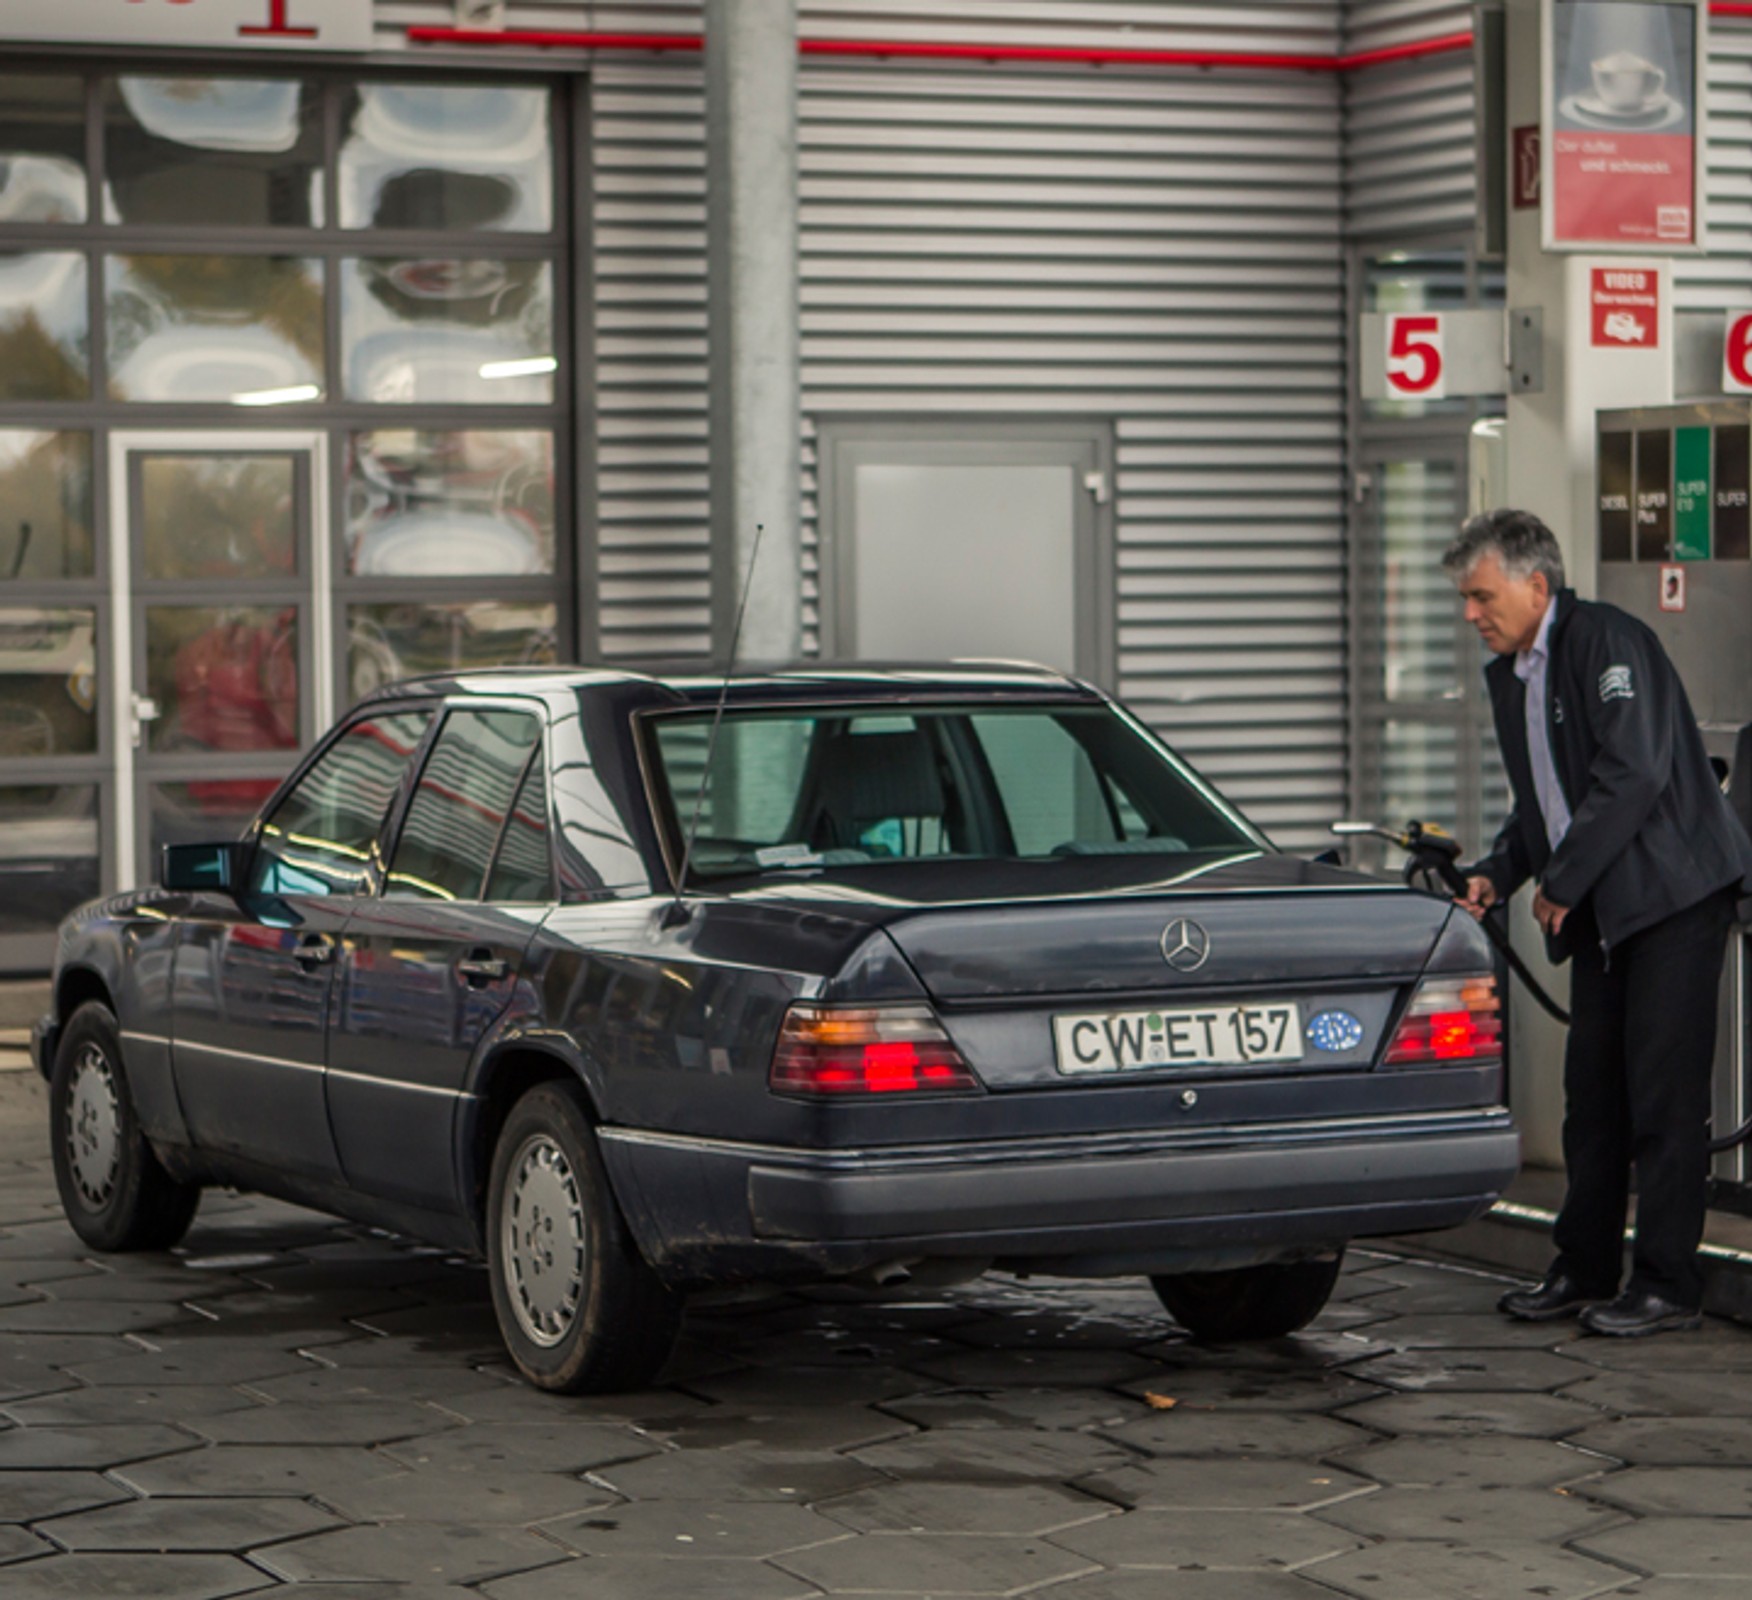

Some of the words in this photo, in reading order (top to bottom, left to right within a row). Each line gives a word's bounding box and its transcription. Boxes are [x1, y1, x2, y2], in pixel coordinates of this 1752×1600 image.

[1603, 272, 1647, 290] VIDEO
[1386, 316, 1442, 393] 5
[1677, 480, 1707, 497] SUPER
[1638, 492, 1667, 509] SUPER
[1717, 492, 1748, 507] SUPER
[1228, 1009, 1291, 1060] 157
